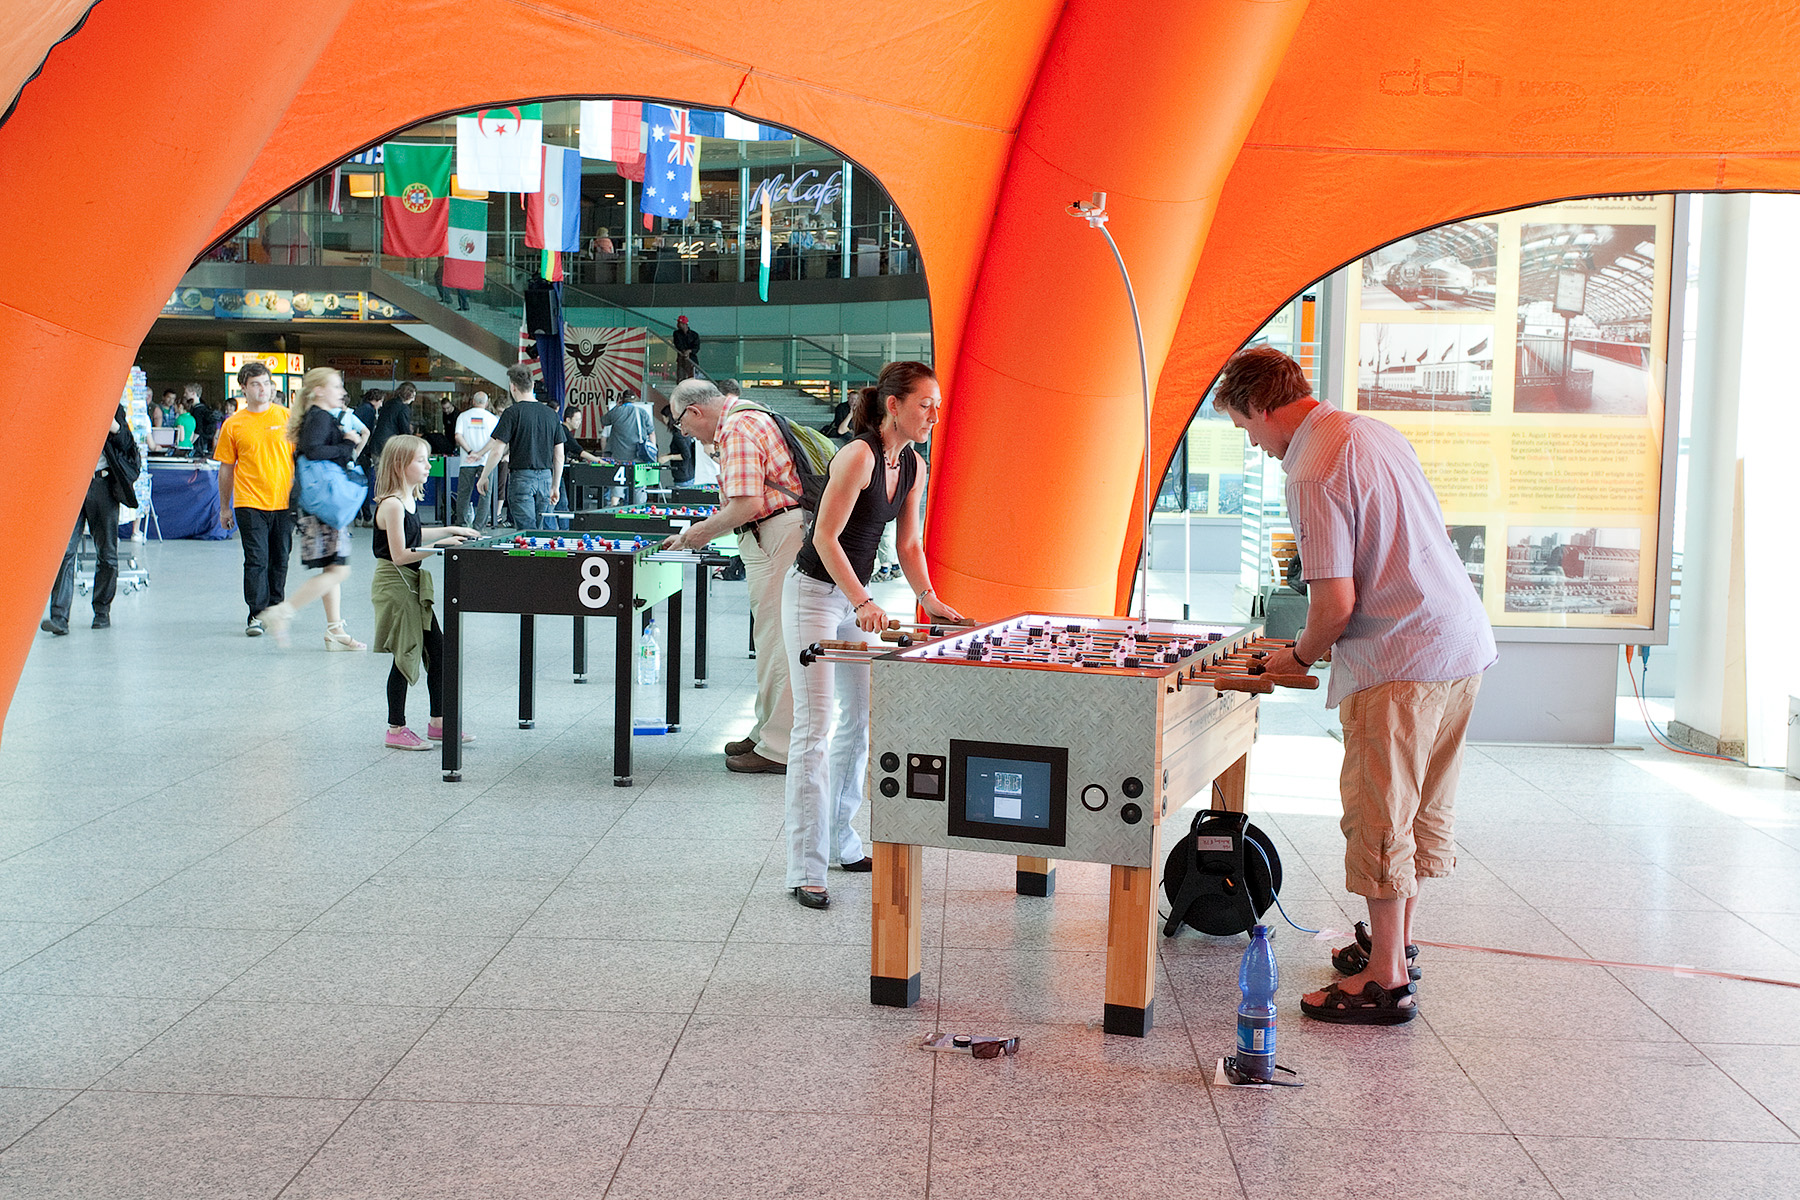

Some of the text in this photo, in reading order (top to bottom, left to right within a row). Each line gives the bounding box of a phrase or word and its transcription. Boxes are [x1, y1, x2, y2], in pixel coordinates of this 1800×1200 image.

[749, 169, 842, 214] McCafé
[569, 387, 602, 406] COPY
[613, 466, 627, 485] 4
[669, 519, 691, 536] 7
[578, 556, 611, 609] 8
